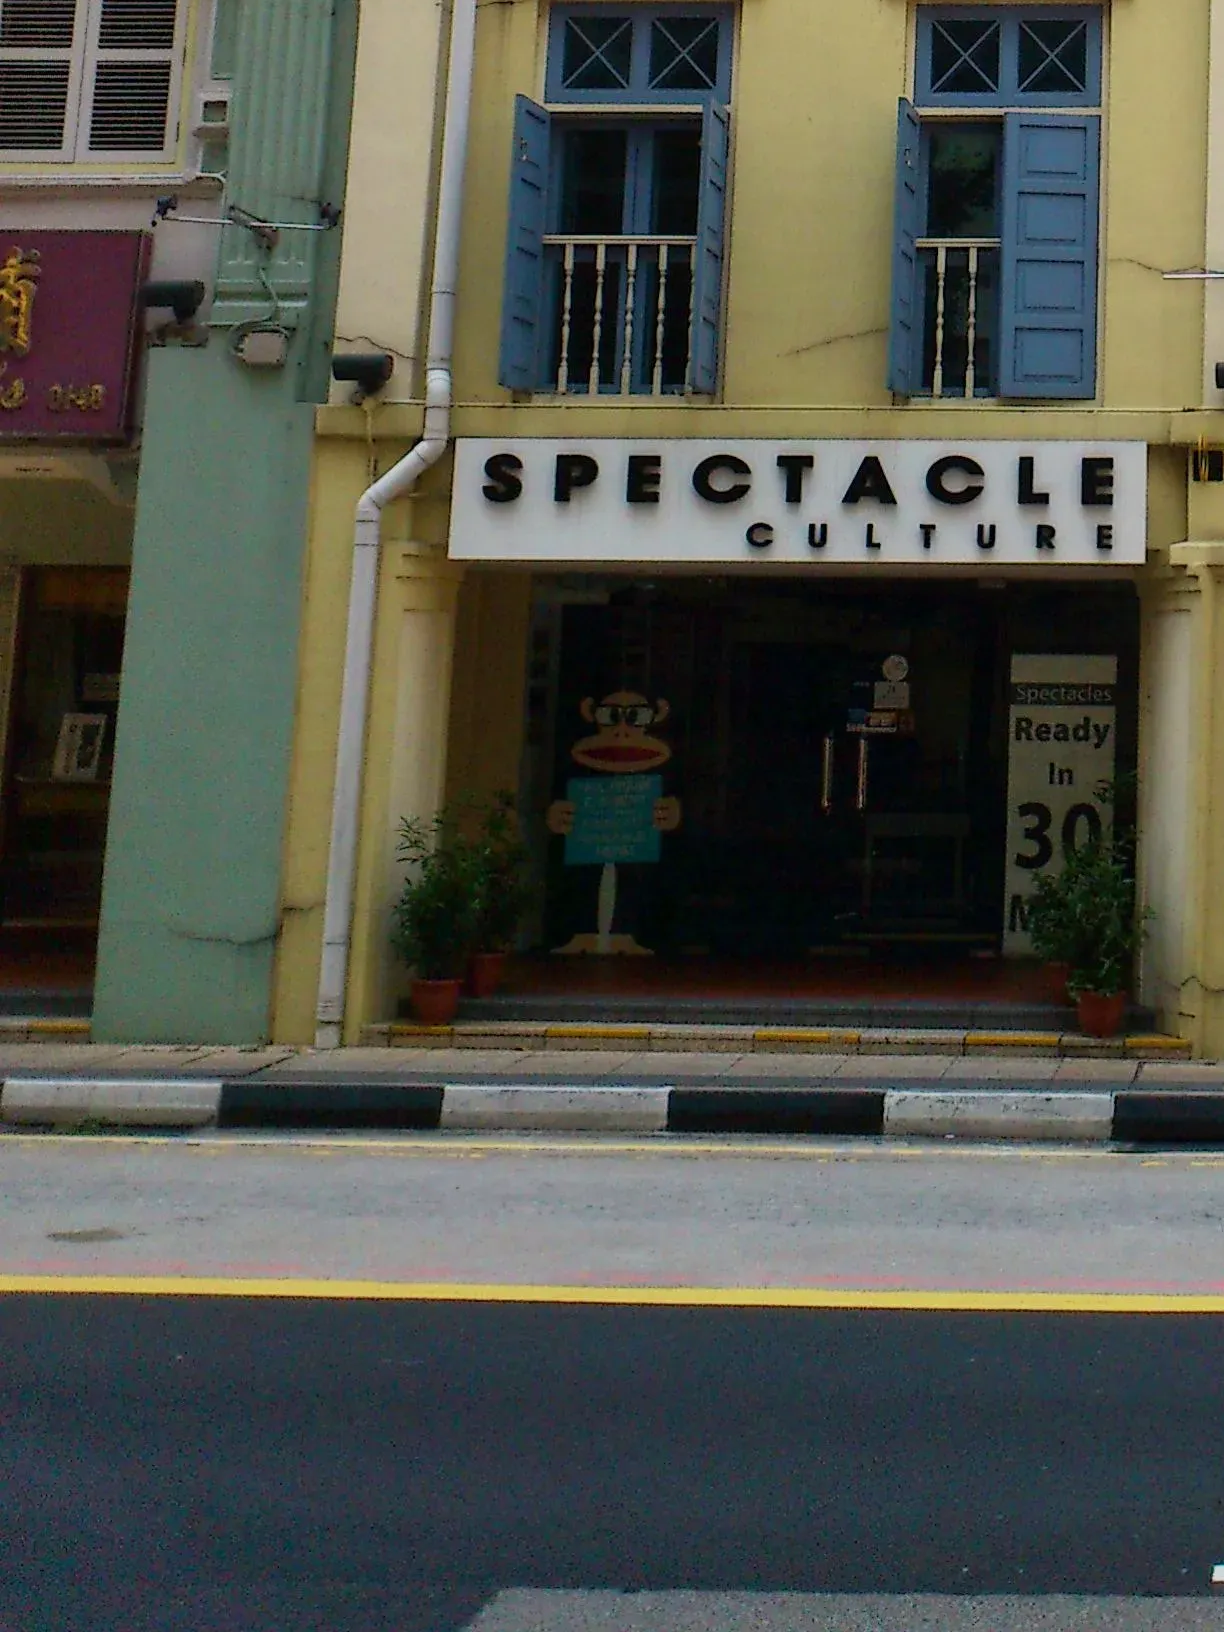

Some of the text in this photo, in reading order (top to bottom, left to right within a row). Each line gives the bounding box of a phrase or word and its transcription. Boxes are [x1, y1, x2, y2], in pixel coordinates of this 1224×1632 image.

[482, 453, 1114, 505] SPECTACLE
[746, 522, 1112, 549] CULTURE
[1015, 683, 1113, 704] Spectacles
[1014, 717, 1110, 748] Ready
[1049, 762, 1074, 785] In
[1015, 802, 1103, 870] 30
